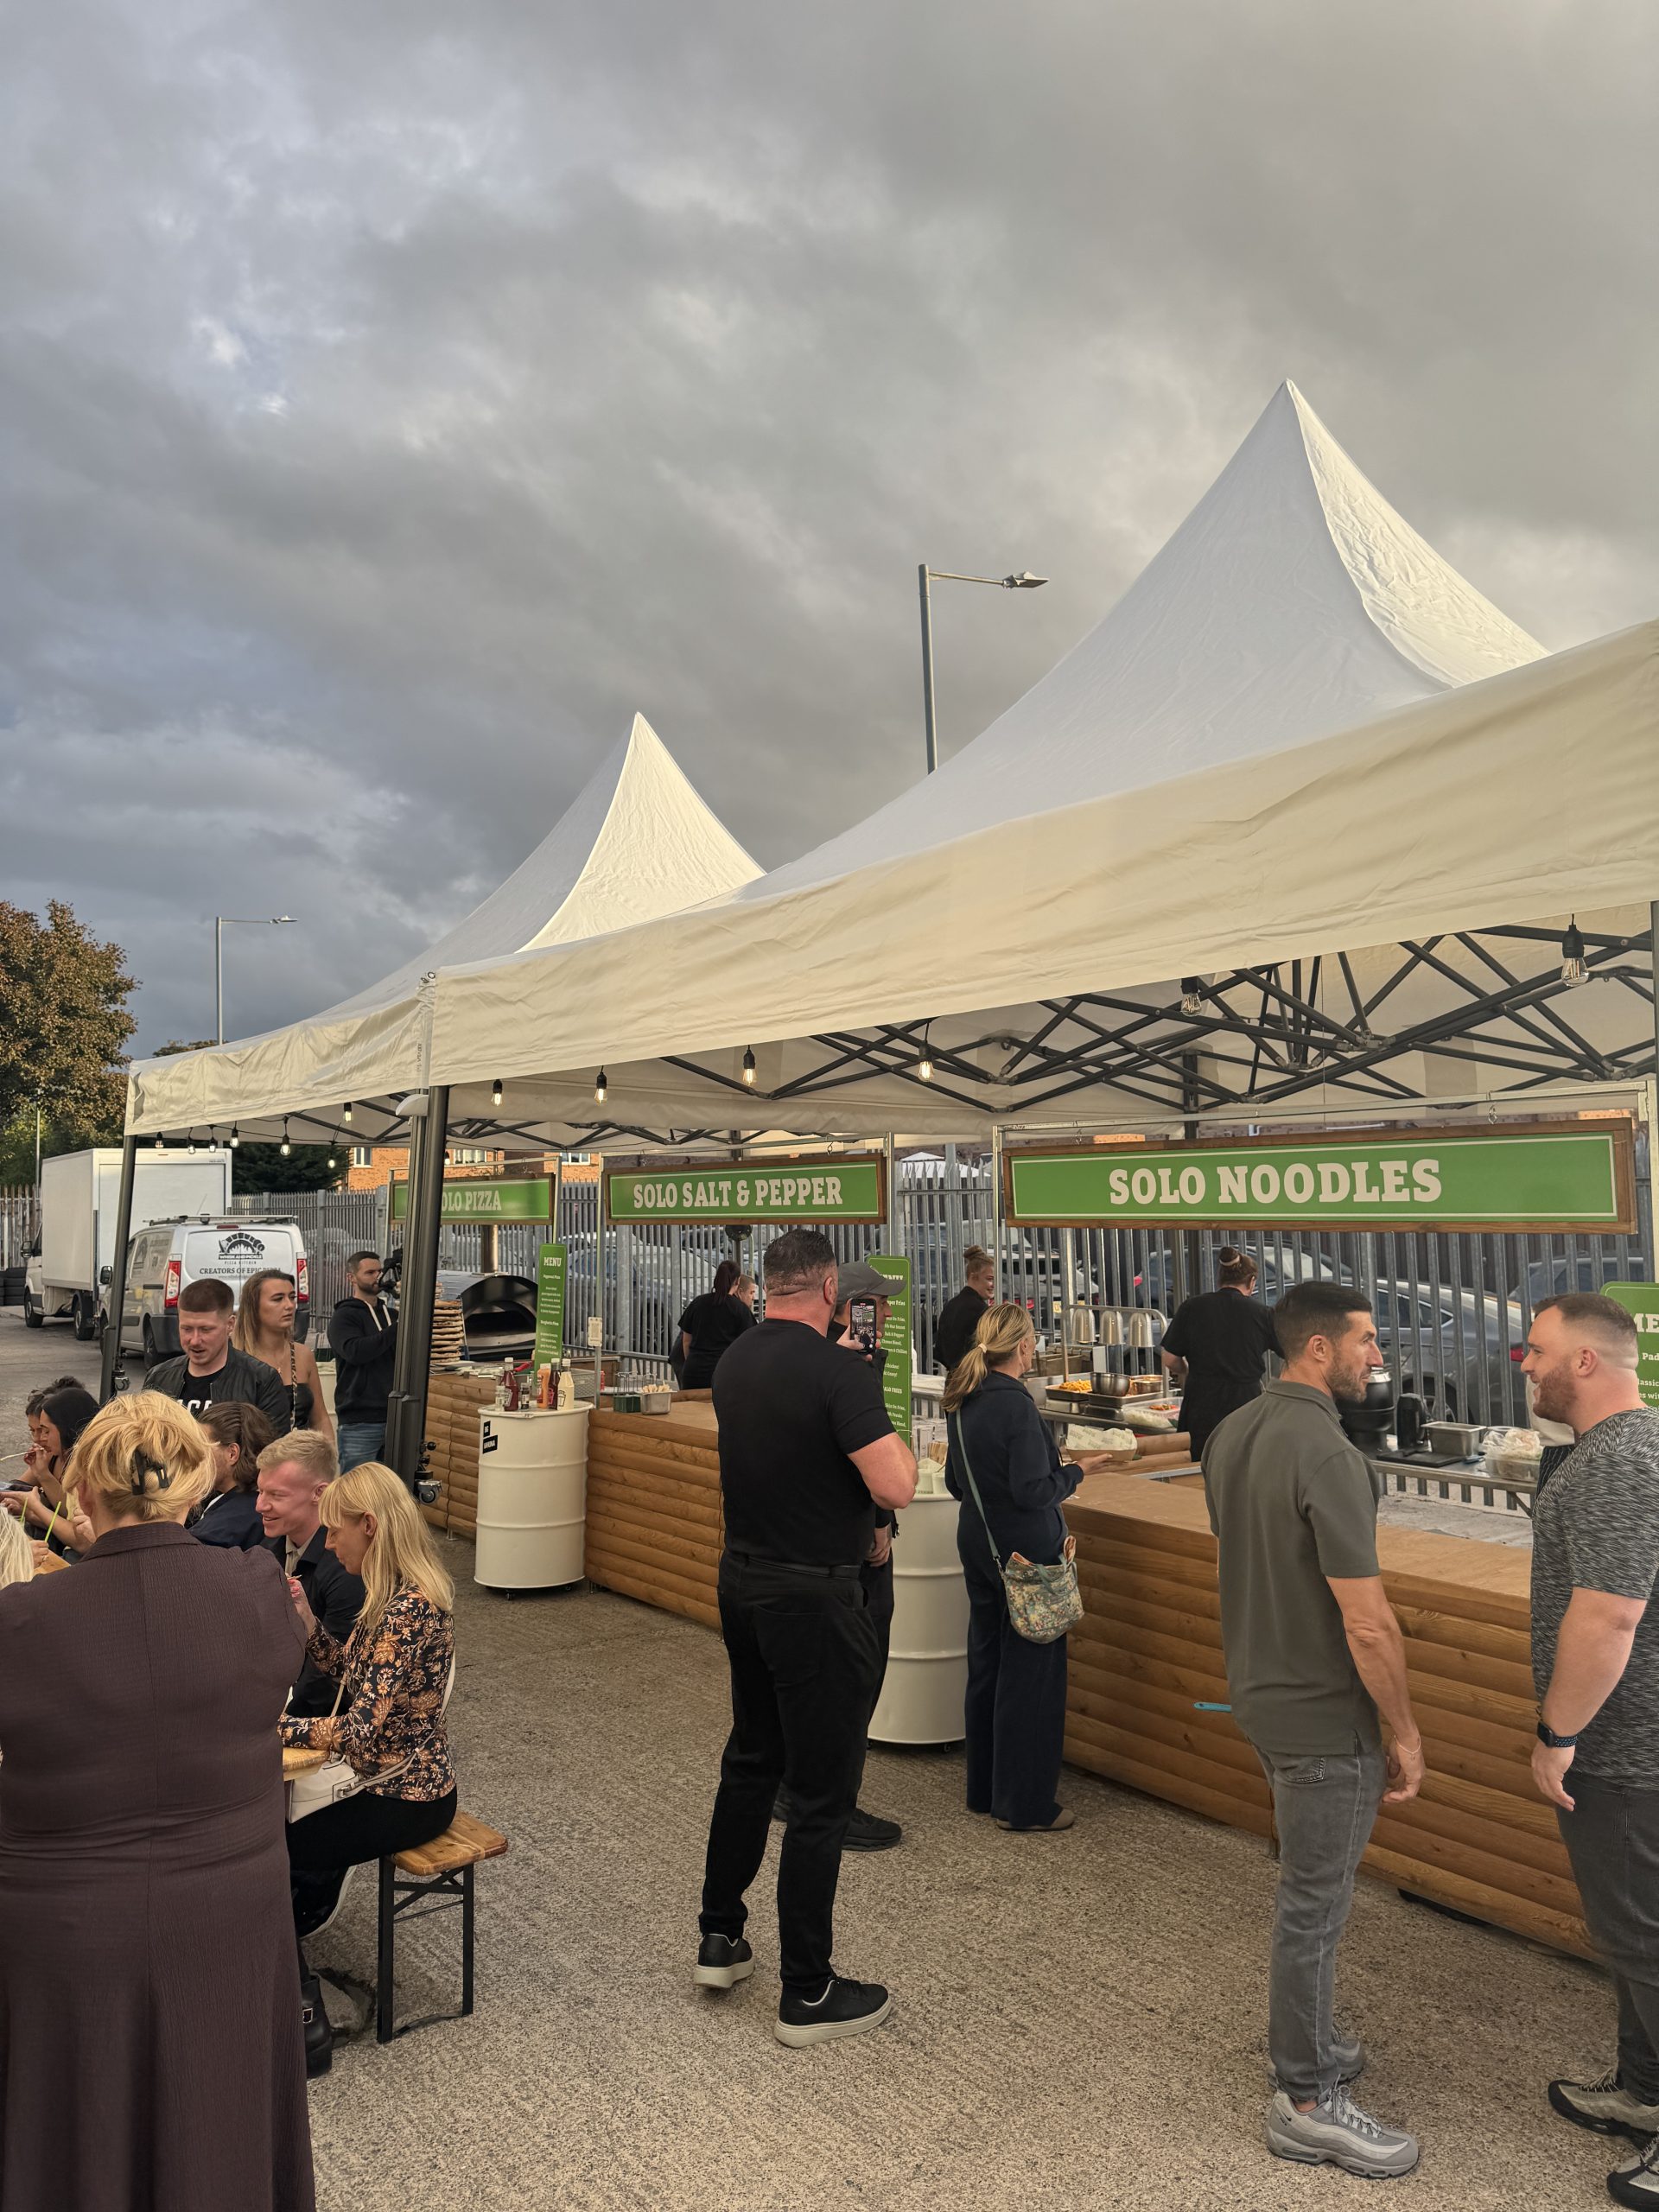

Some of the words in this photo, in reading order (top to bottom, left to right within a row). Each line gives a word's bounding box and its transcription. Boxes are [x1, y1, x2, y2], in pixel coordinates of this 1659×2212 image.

[633, 1182, 678, 1209] SOLO
[683, 1180, 732, 1208] SALT
[736, 1179, 750, 1207] &
[754, 1176, 843, 1206] PEPPER
[1109, 1166, 1206, 1205] SOLO
[1217, 1159, 1442, 1204] NOODLES
[442, 1191, 462, 1211] OLO
[465, 1190, 502, 1211] PIZZA
[543, 1256, 562, 1267] MENU
